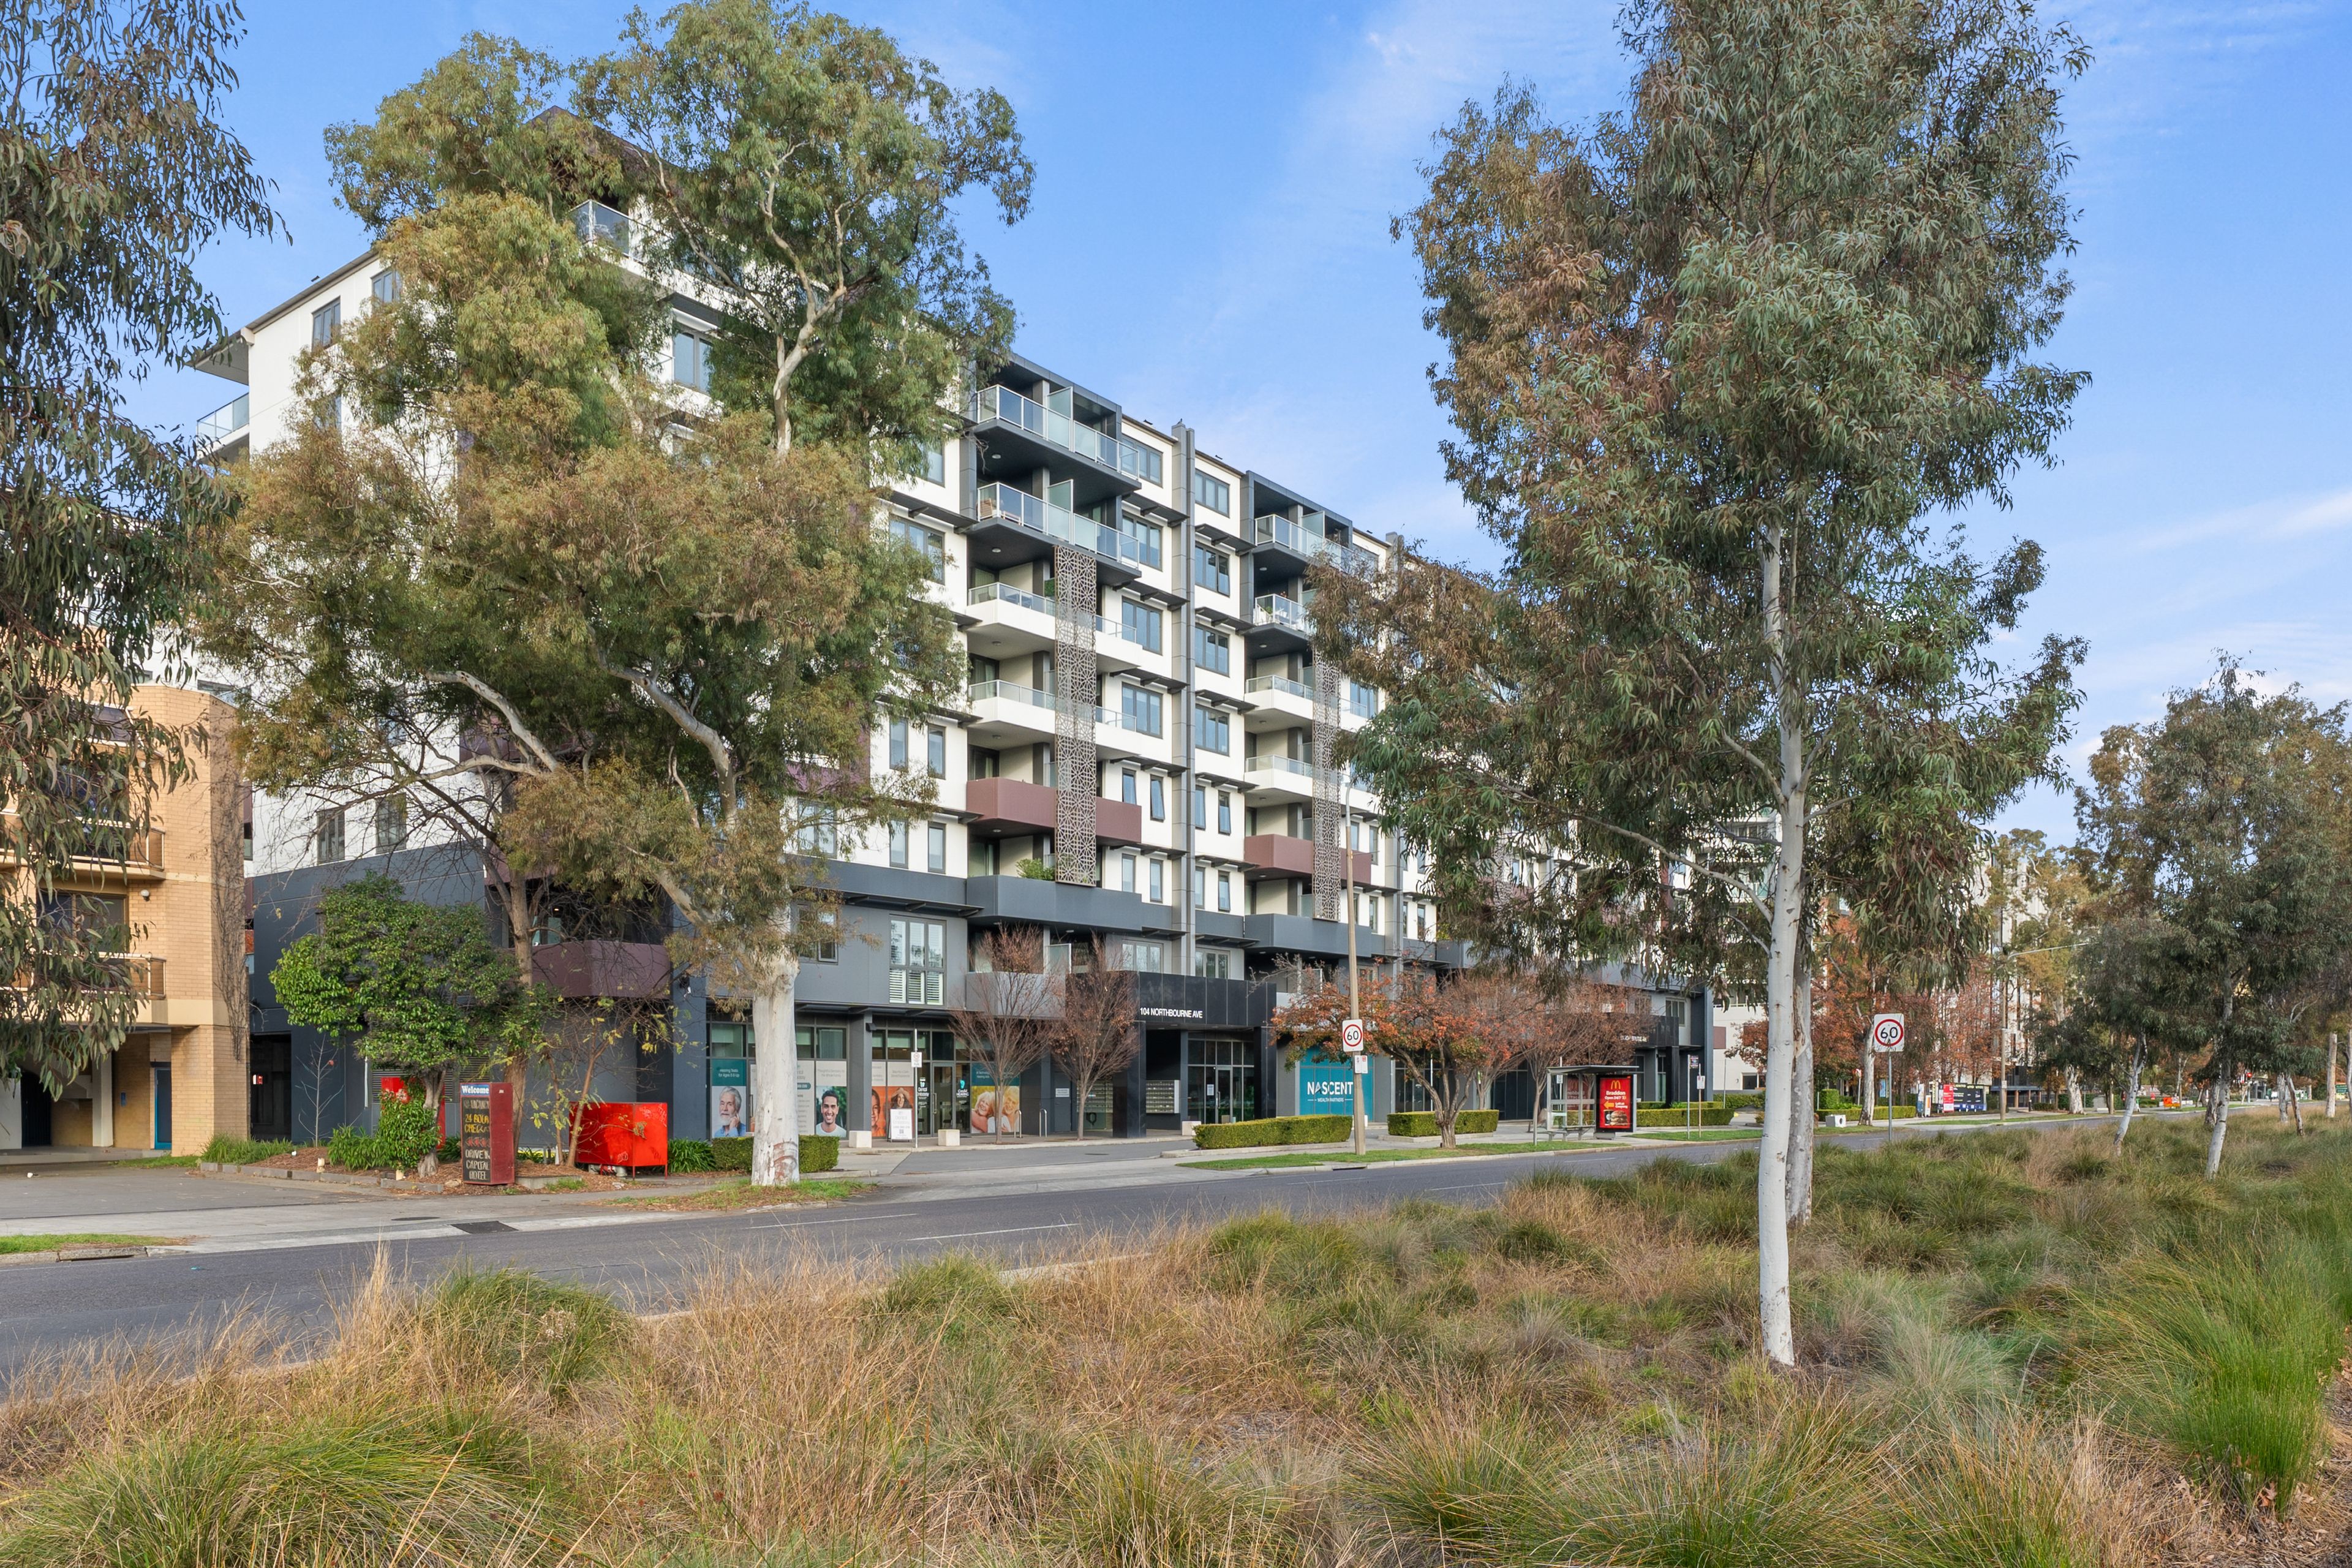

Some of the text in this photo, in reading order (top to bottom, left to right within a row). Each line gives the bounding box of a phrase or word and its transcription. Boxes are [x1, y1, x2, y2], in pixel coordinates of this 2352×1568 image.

[1150, 1008, 1192, 1017] NORTHBOURNE
[1347, 1030, 1359, 1041] 60
[1880, 1027, 1898, 1039] 60
[461, 1085, 489, 1094] Welcome
[1307, 1082, 1354, 1095] NASCENT
[465, 1114, 472, 1123] 24
